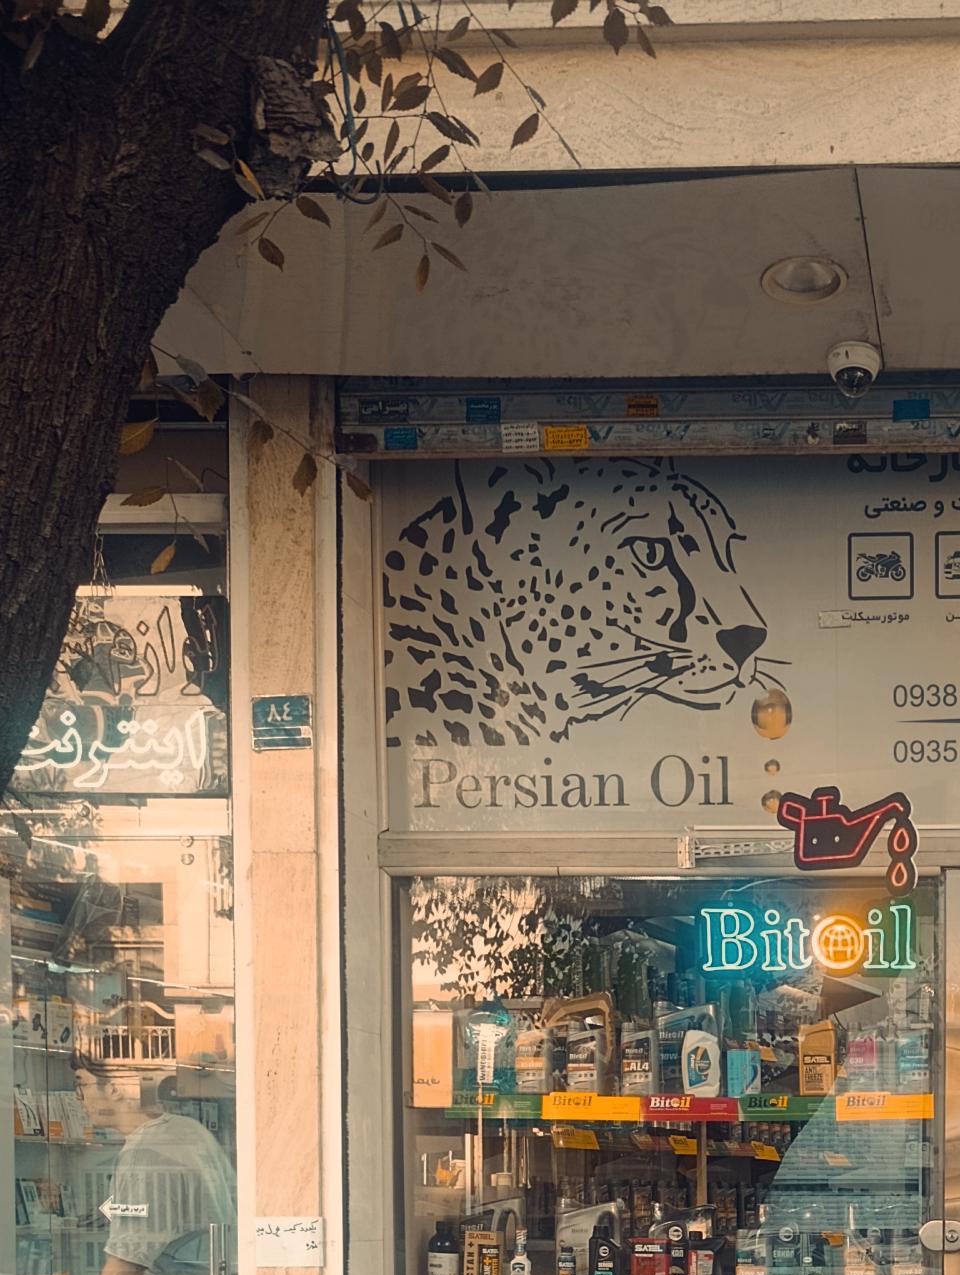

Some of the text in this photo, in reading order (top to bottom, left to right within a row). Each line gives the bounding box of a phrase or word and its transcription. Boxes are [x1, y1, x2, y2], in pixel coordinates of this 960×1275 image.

[863, 498, 927, 518] صنعتی
[934, 503, 945, 517] و
[893, 684, 958, 708] 0938
[893, 740, 958, 764] 0935
[413, 755, 735, 810] Persian Oil
